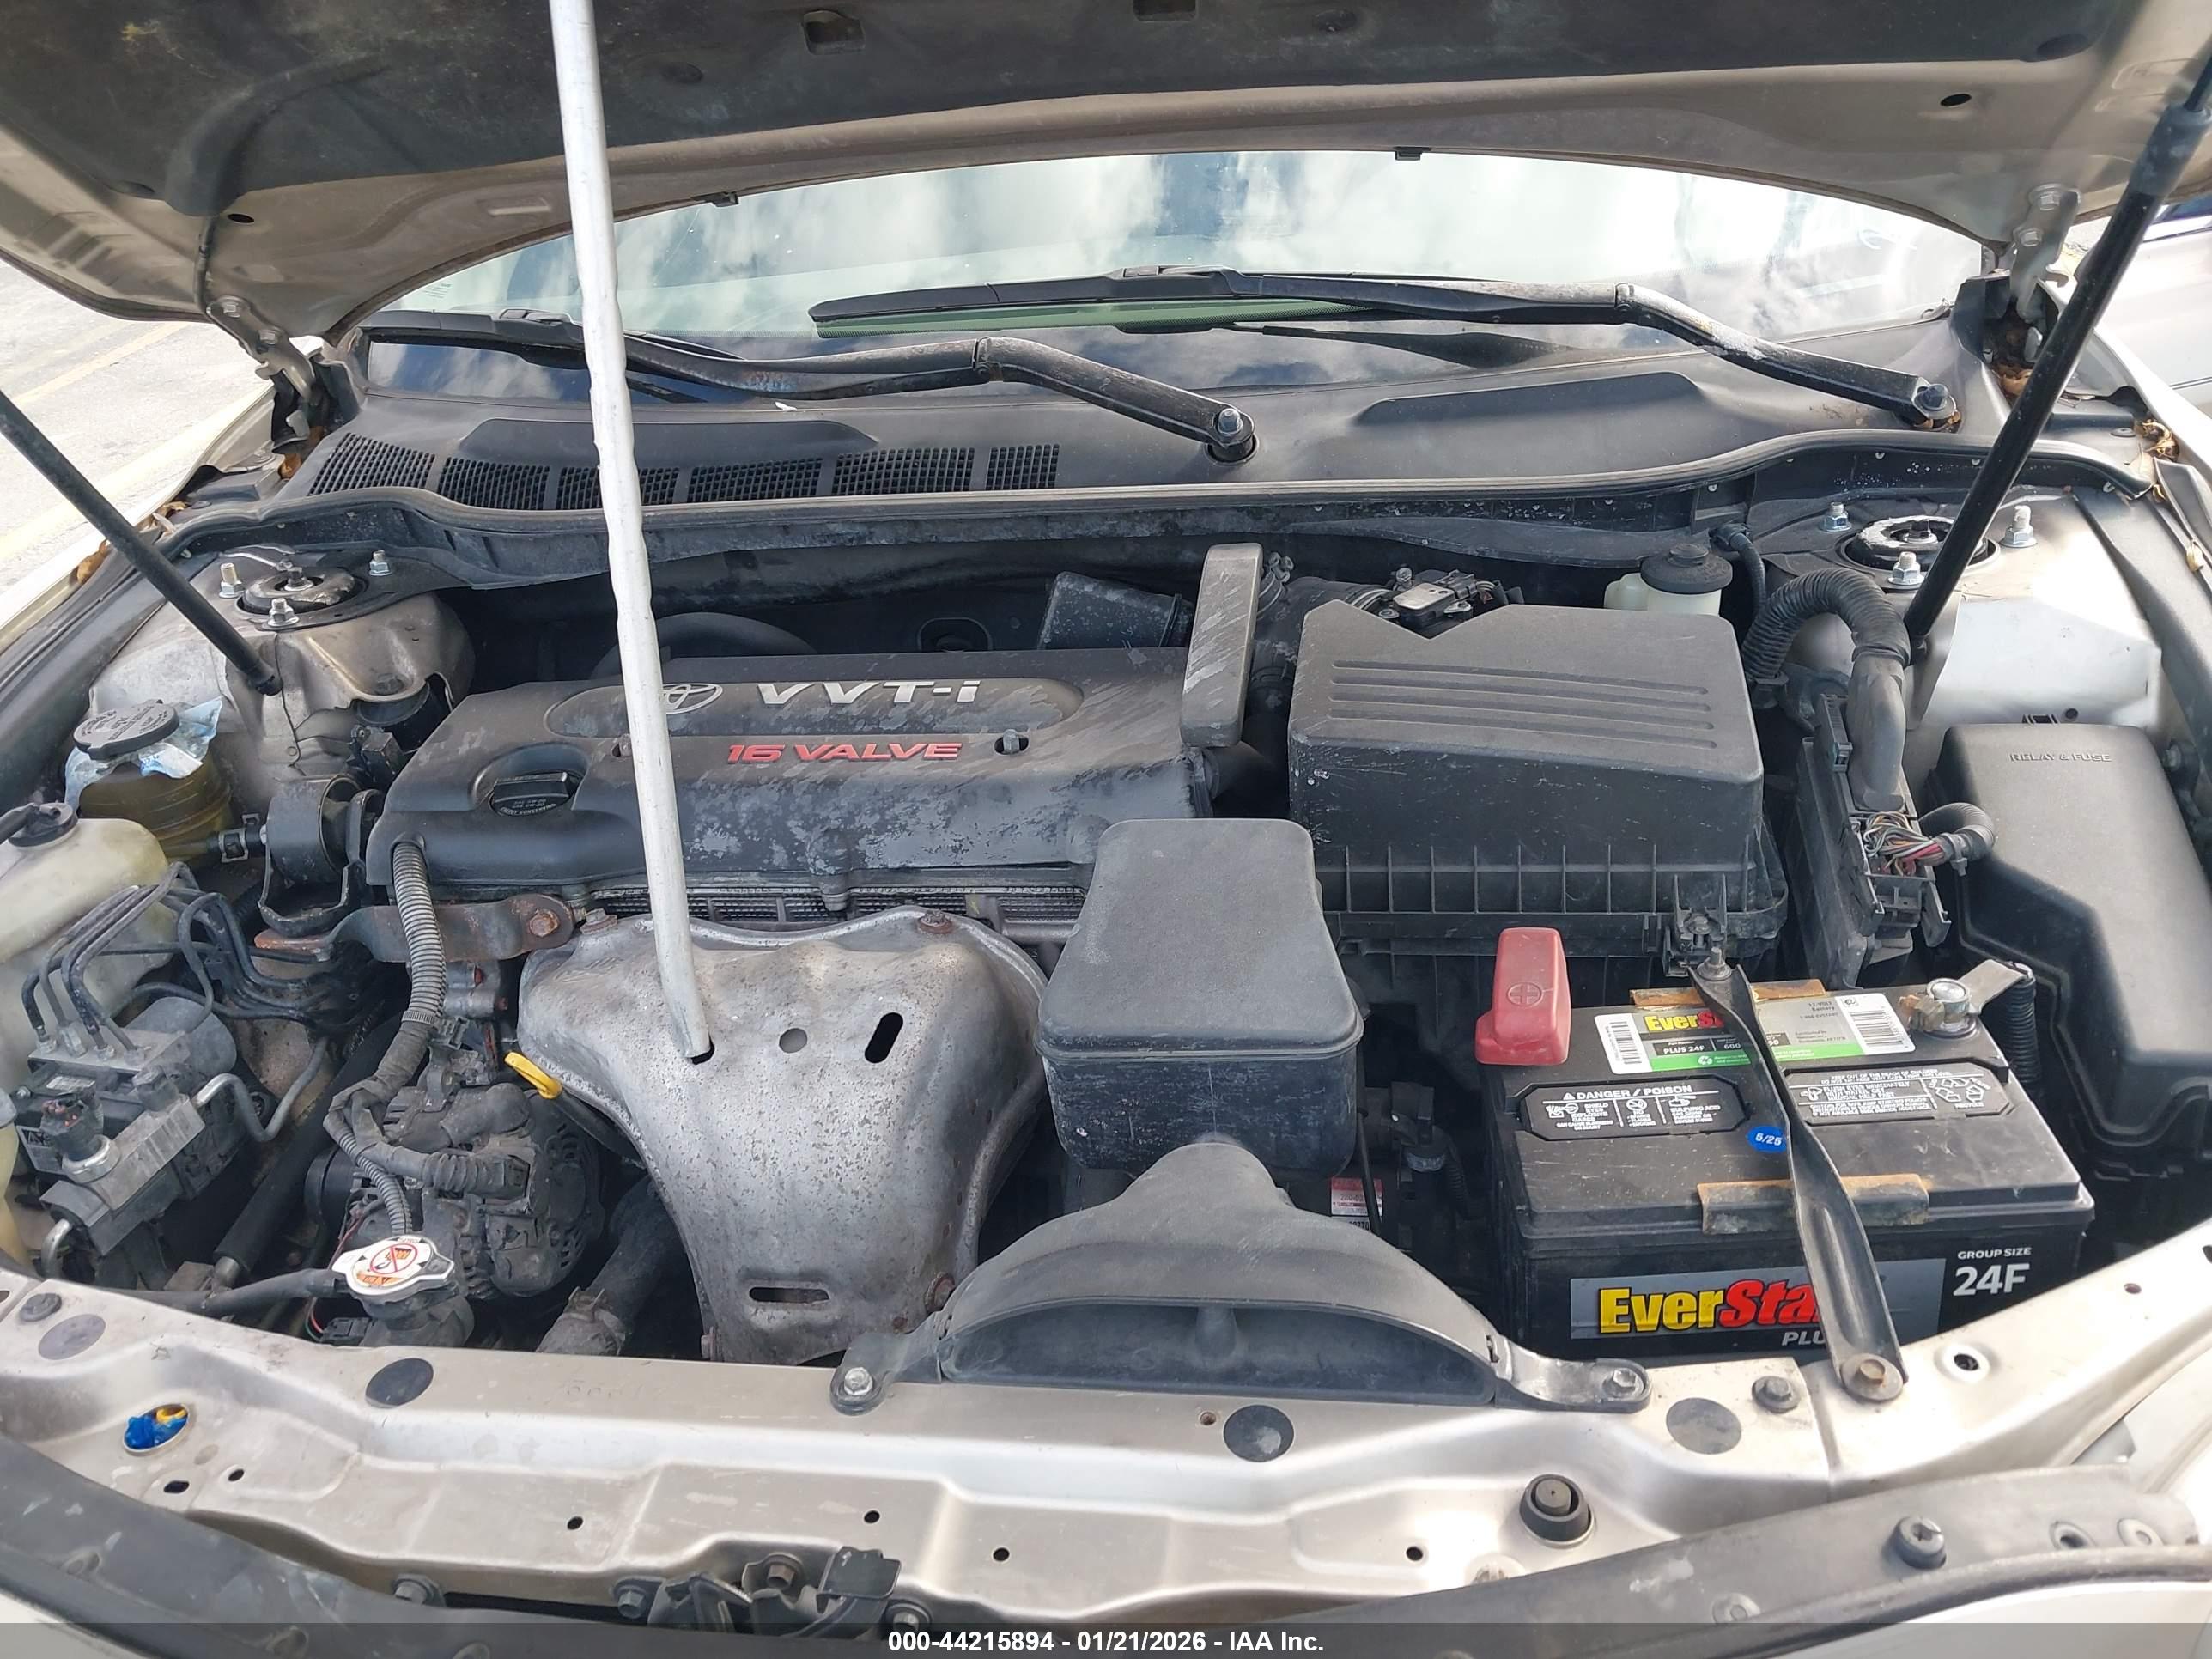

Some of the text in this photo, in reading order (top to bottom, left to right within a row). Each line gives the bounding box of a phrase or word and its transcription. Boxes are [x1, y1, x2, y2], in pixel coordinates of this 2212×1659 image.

[757, 681, 981, 705] VVT-i
[728, 743, 962, 763] 16 VALVE
[2072, 754, 2112, 763] FUSE
[1644, 1011, 1724, 1031] EverS
[1663, 1046, 1686, 1054] PLUS
[1577, 1089, 1631, 1099] DANGER
[1644, 1085, 1692, 1095] POISON
[1755, 1133, 1783, 1146] 5/25
[1958, 1247, 2032, 1260] GROUP SIZE
[1953, 1262, 2030, 1297] 24F
[1600, 1279, 1820, 1333] EverSta
[1781, 1330, 1827, 1346] PLU
